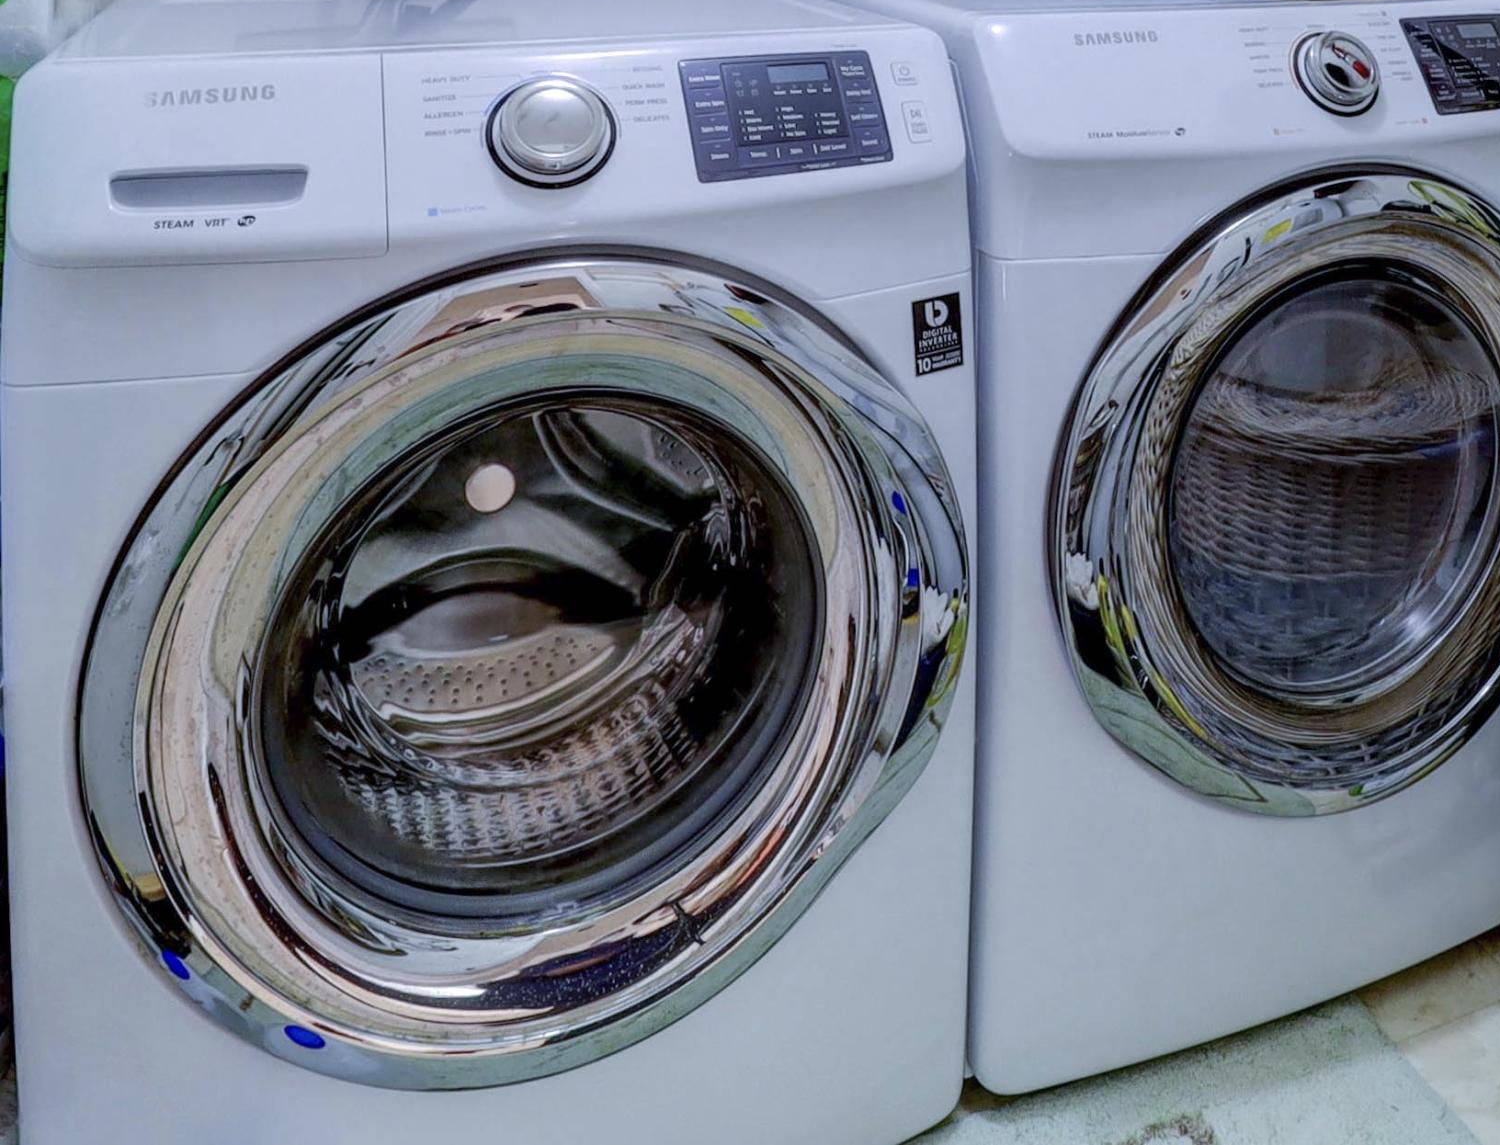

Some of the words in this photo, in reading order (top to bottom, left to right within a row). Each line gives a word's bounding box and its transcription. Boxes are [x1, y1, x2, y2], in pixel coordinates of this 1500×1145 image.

[1073, 31, 1158, 46] SAMSUNG
[144, 84, 276, 108] SAMSUNG
[153, 219, 195, 230] STEAM
[918, 331, 958, 348] INVERTER
[922, 324, 953, 340] DIGITAL
[916, 356, 932, 374] 10
